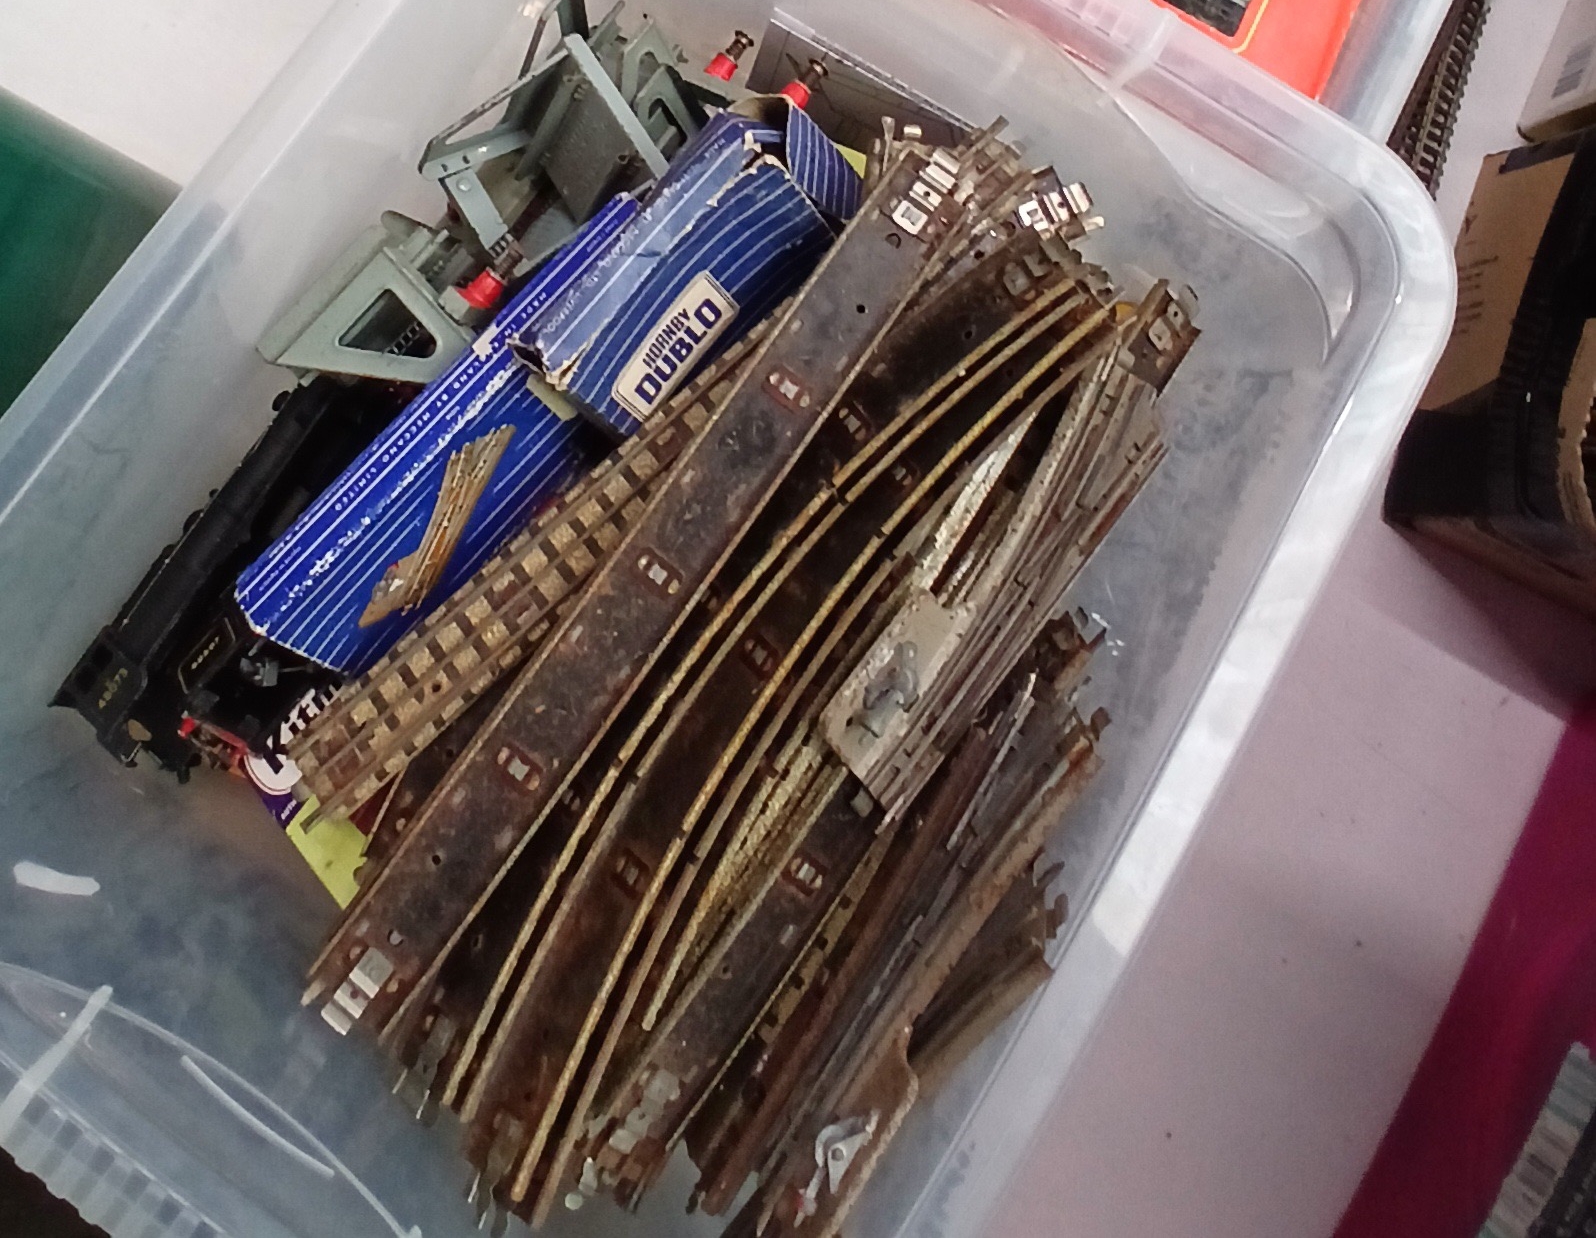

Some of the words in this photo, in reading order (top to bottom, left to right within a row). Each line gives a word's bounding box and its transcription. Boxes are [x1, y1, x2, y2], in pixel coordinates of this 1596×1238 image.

[521, 292, 547, 319] MADE
[504, 323, 517, 337] IN
[634, 298, 722, 405] DUBLO
[642, 308, 691, 370] HORNBY
[435, 393, 449, 408] BY
[382, 411, 431, 463] MECCANO
[335, 467, 377, 512] LIMITED
